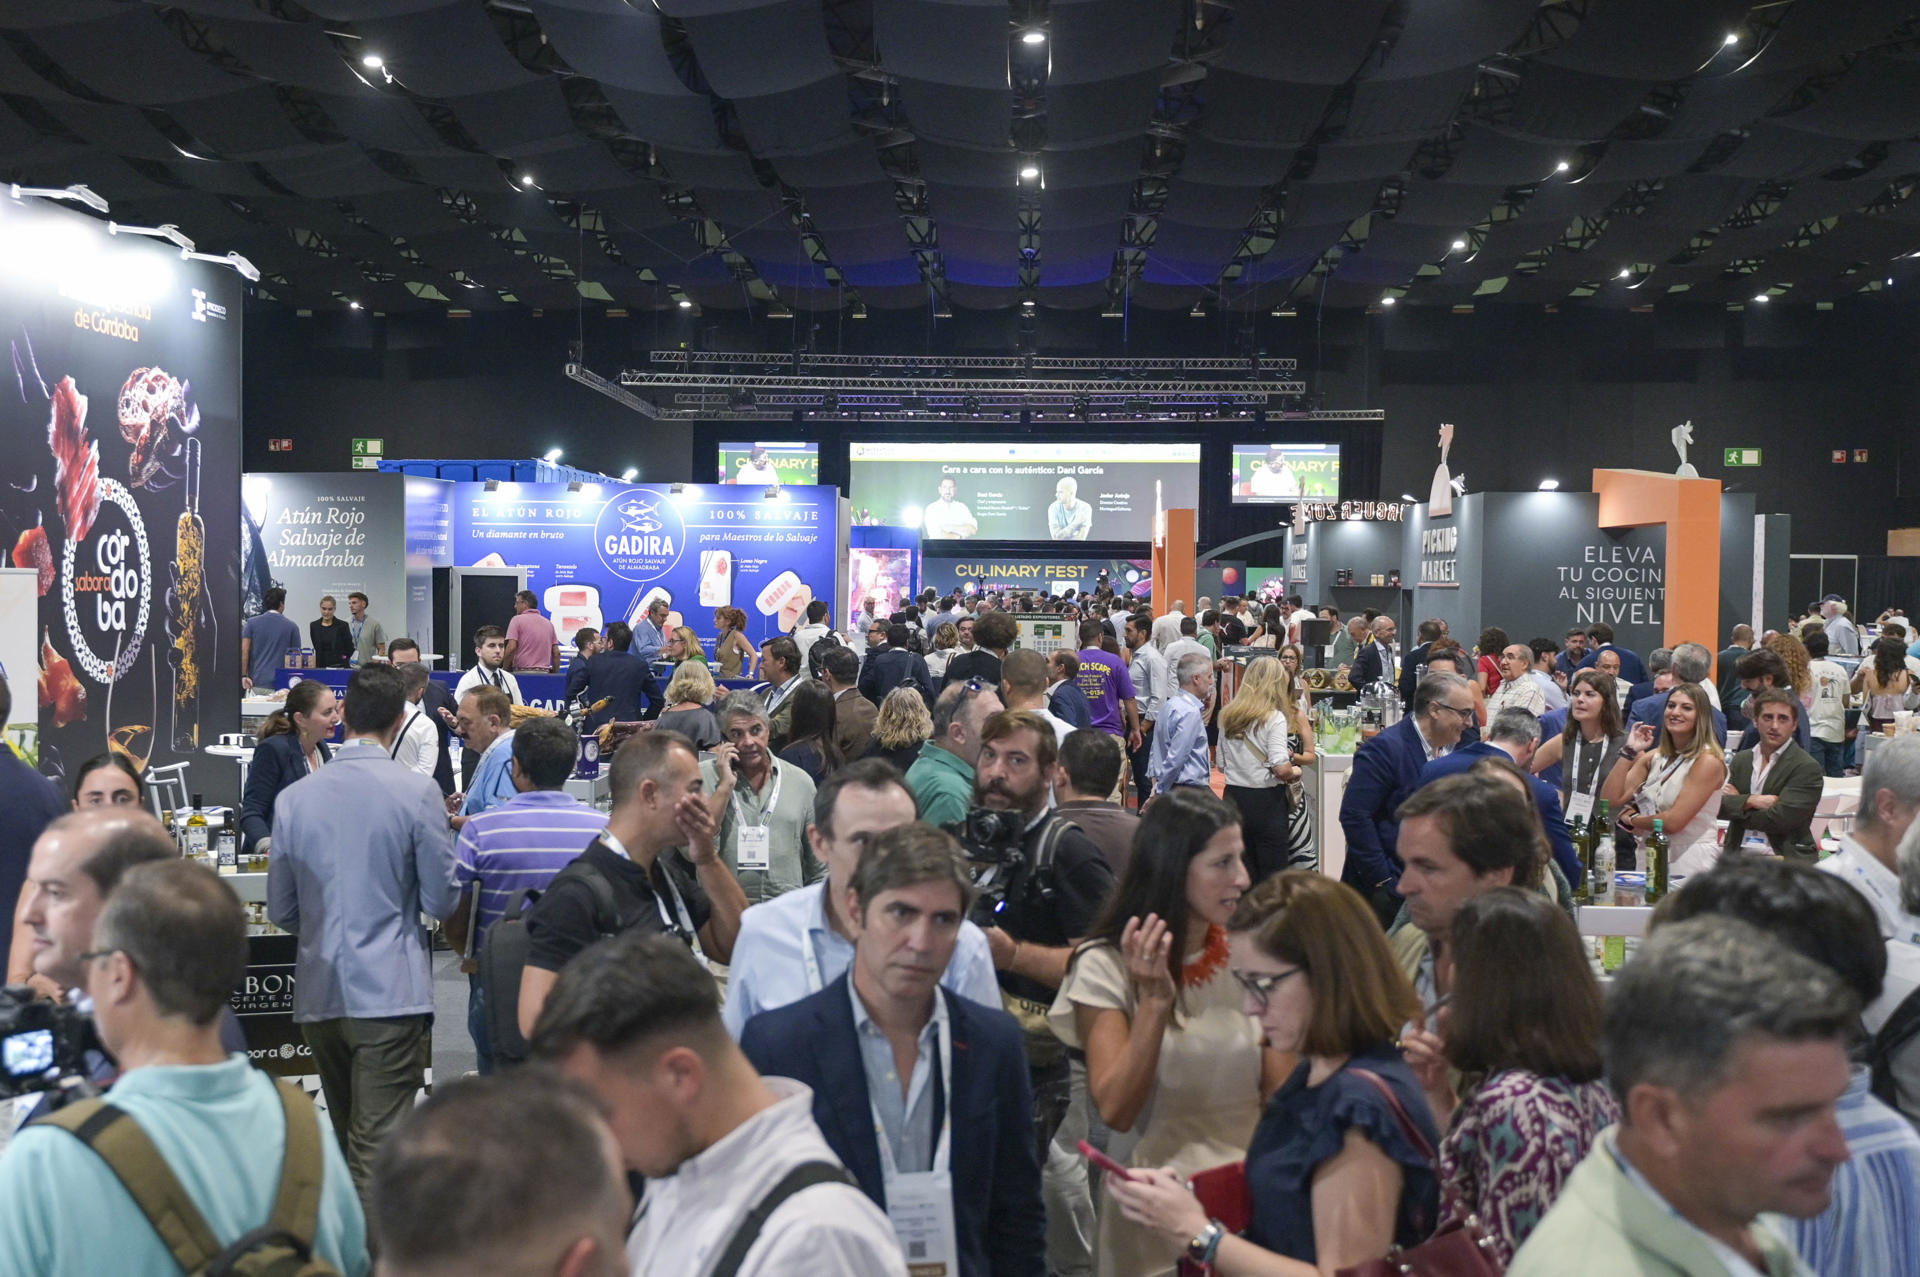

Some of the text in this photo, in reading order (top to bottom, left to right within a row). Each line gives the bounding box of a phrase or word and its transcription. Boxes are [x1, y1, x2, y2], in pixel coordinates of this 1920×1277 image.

[74, 307, 139, 342] de Córdoba
[736, 457, 808, 469] CNARY
[942, 465, 961, 474] Cara
[1005, 465, 1013, 474] lo
[1015, 466, 1055, 474] auténtico:
[1057, 466, 1075, 474] Dani
[1078, 465, 1104, 475] García
[1250, 460, 1329, 472] CNARY
[277, 505, 365, 529] Atún Rojo
[472, 504, 583, 520] EL ATÚN ROJO
[709, 510, 818, 521] 100% SALVAJE
[279, 527, 366, 550] Salvaje de
[472, 529, 485, 539] Un
[486, 530, 527, 539] diamante
[540, 531, 565, 540] bruto
[699, 532, 818, 544] para Maestros de lo Salvaje
[1422, 526, 1457, 554] PICKING
[604, 534, 675, 556] GADIRA
[268, 549, 365, 567] Almadraba
[612, 556, 627, 564] ATÚN
[1584, 546, 1656, 563] ELEVA
[956, 564, 1089, 578] CULINARY FEST
[1422, 560, 1456, 581] MARKET
[1557, 566, 1583, 582] TU
[1559, 587, 1579, 600] AL
[1576, 602, 1661, 625] NIVEL
[1079, 662, 1090, 671] CH
[232, 1002, 291, 1010] VIRGEN
